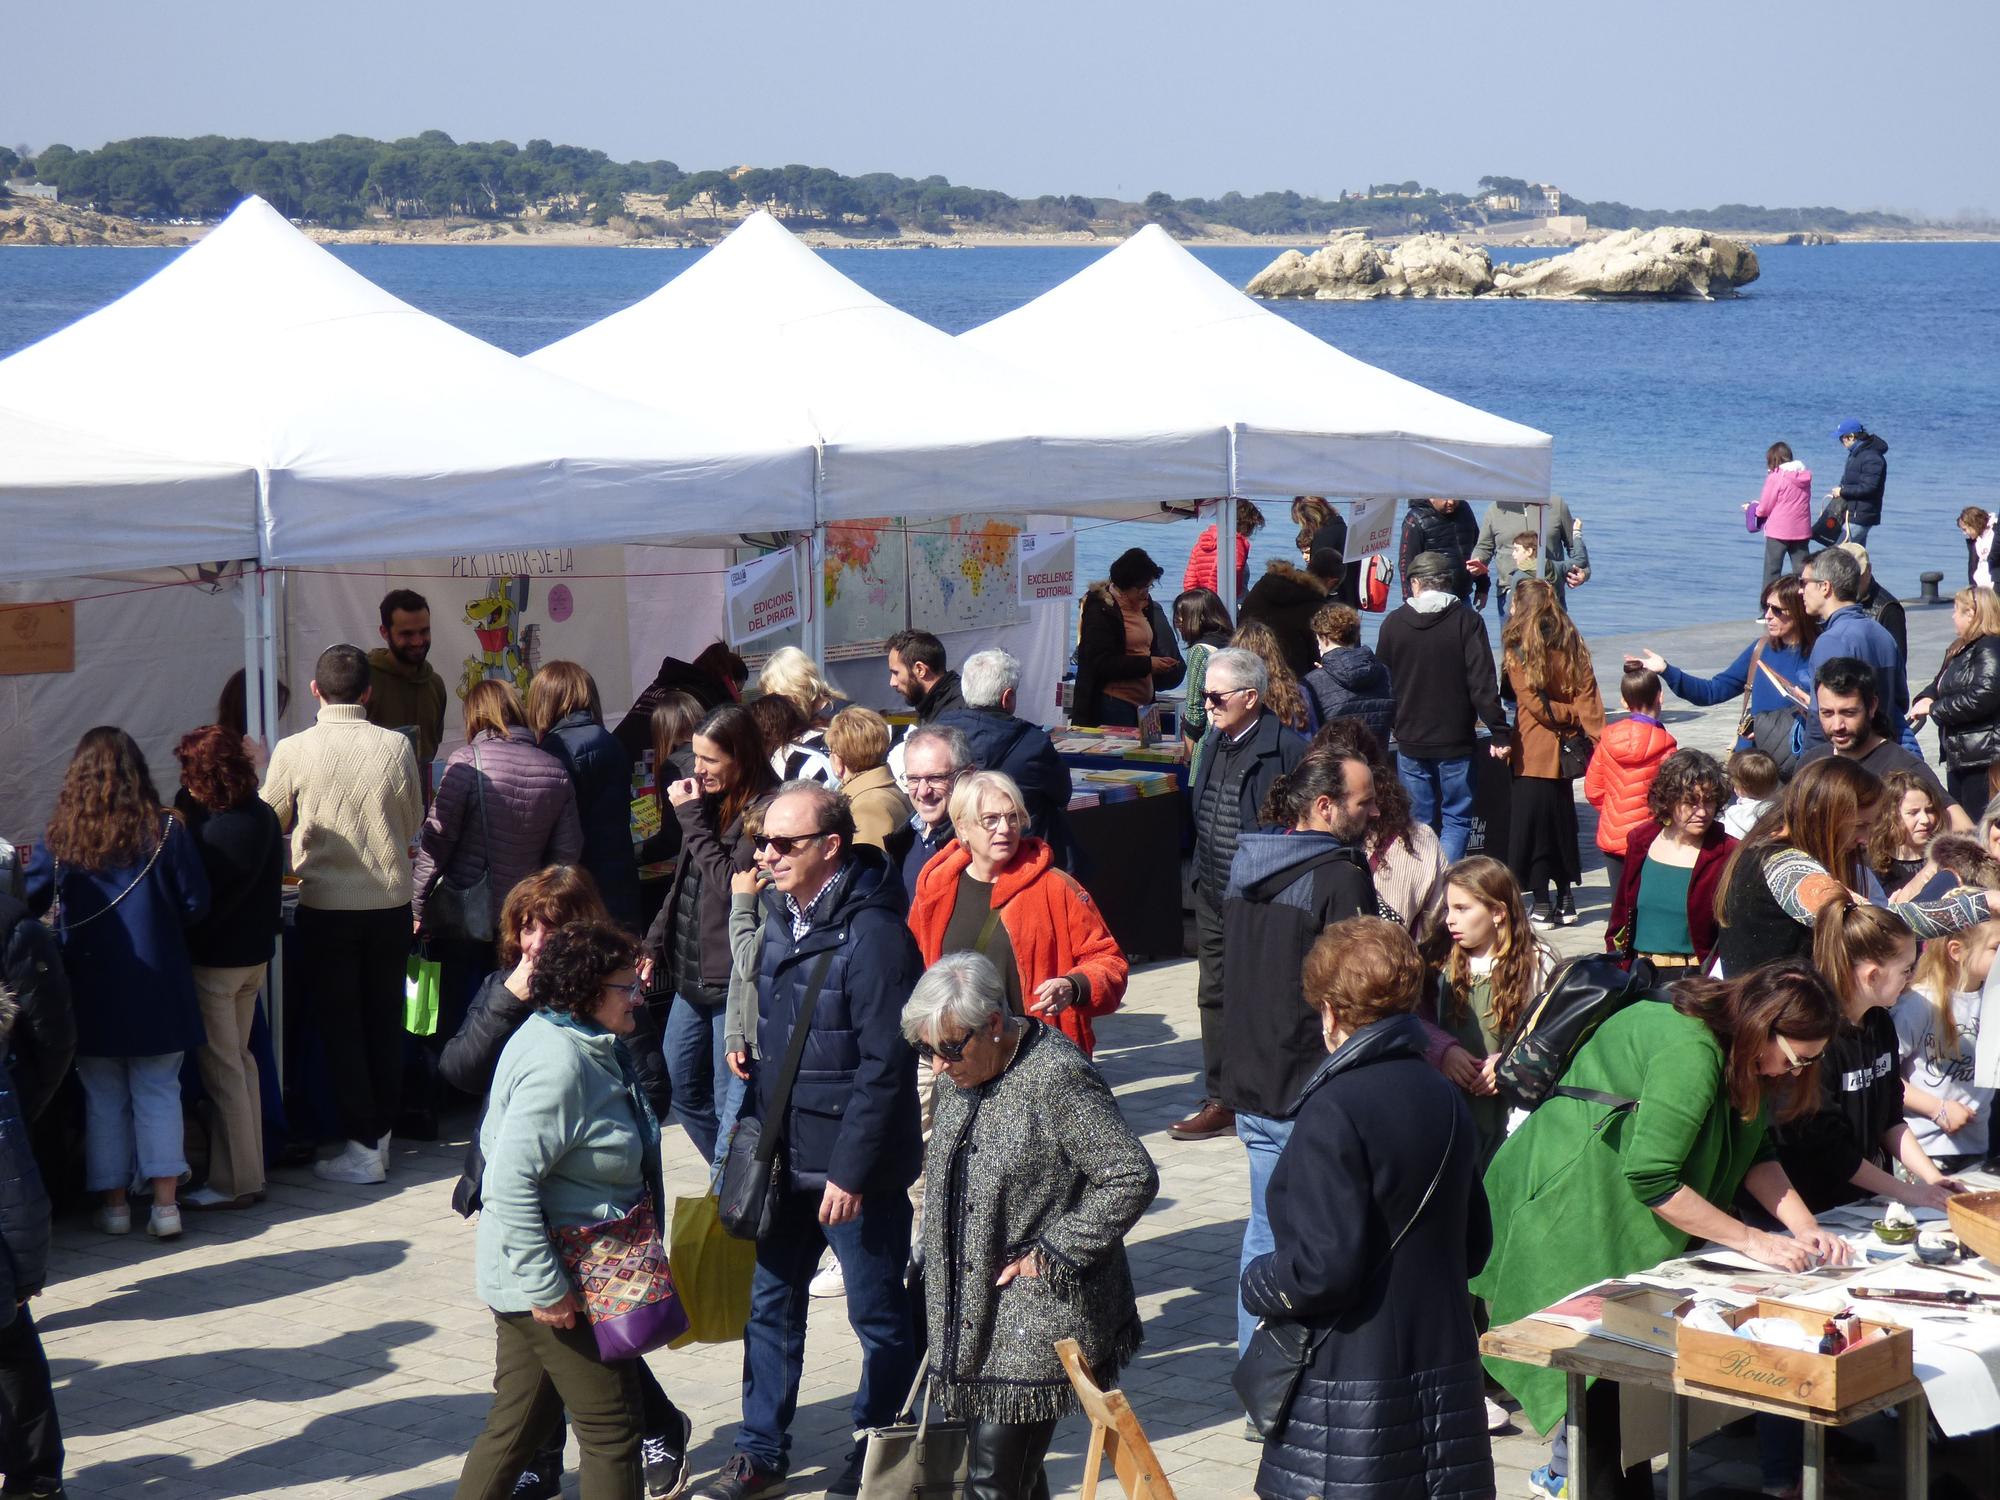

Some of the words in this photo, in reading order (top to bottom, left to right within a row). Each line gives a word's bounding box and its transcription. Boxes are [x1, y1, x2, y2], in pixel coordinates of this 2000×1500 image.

[452, 555, 479, 577] PER
[1027, 571, 1073, 585] EXCELLENCE
[753, 591, 794, 616] EDICIONS
[1036, 585, 1073, 599] EDITORIAL
[748, 618, 766, 632] DEL
[766, 606, 795, 625] PIRATA
[1716, 1350, 1790, 1388] Roura
